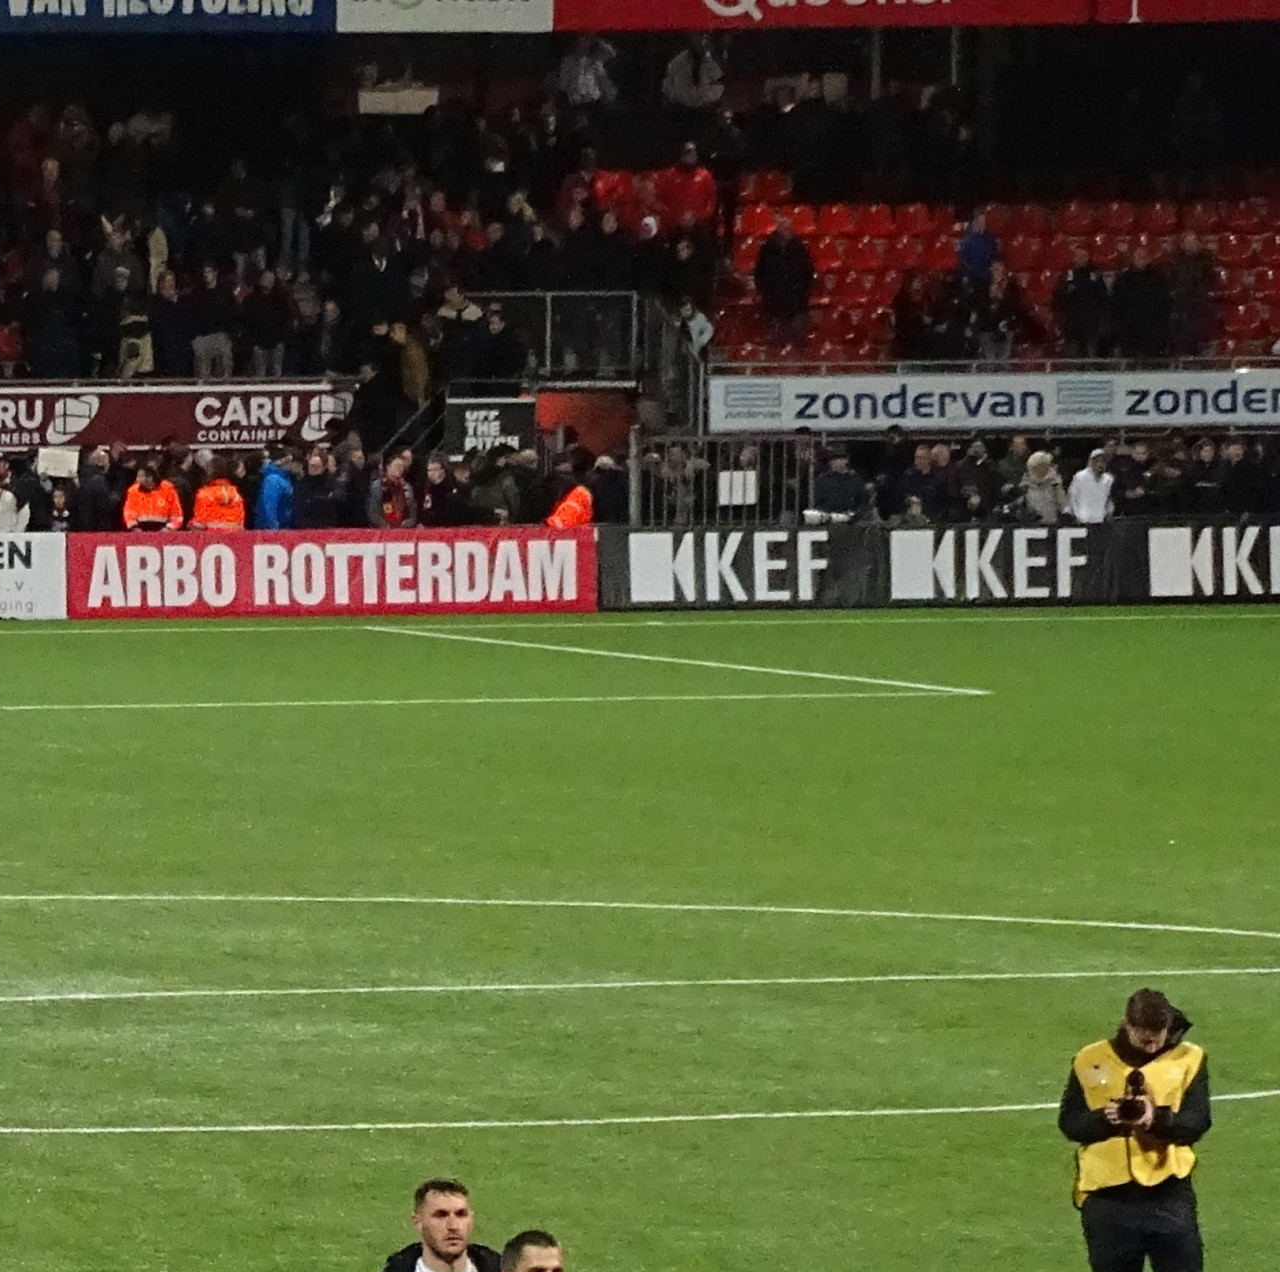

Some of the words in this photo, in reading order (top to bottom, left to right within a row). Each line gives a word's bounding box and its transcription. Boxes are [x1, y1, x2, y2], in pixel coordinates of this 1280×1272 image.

[195, 396, 299, 427] CARU
[794, 383, 1045, 421] zondervan
[197, 429, 287, 441] CONTAINER
[465, 421, 501, 436] THE
[87, 543, 238, 608] ARBO
[252, 539, 578, 608] ROTTERDAM
